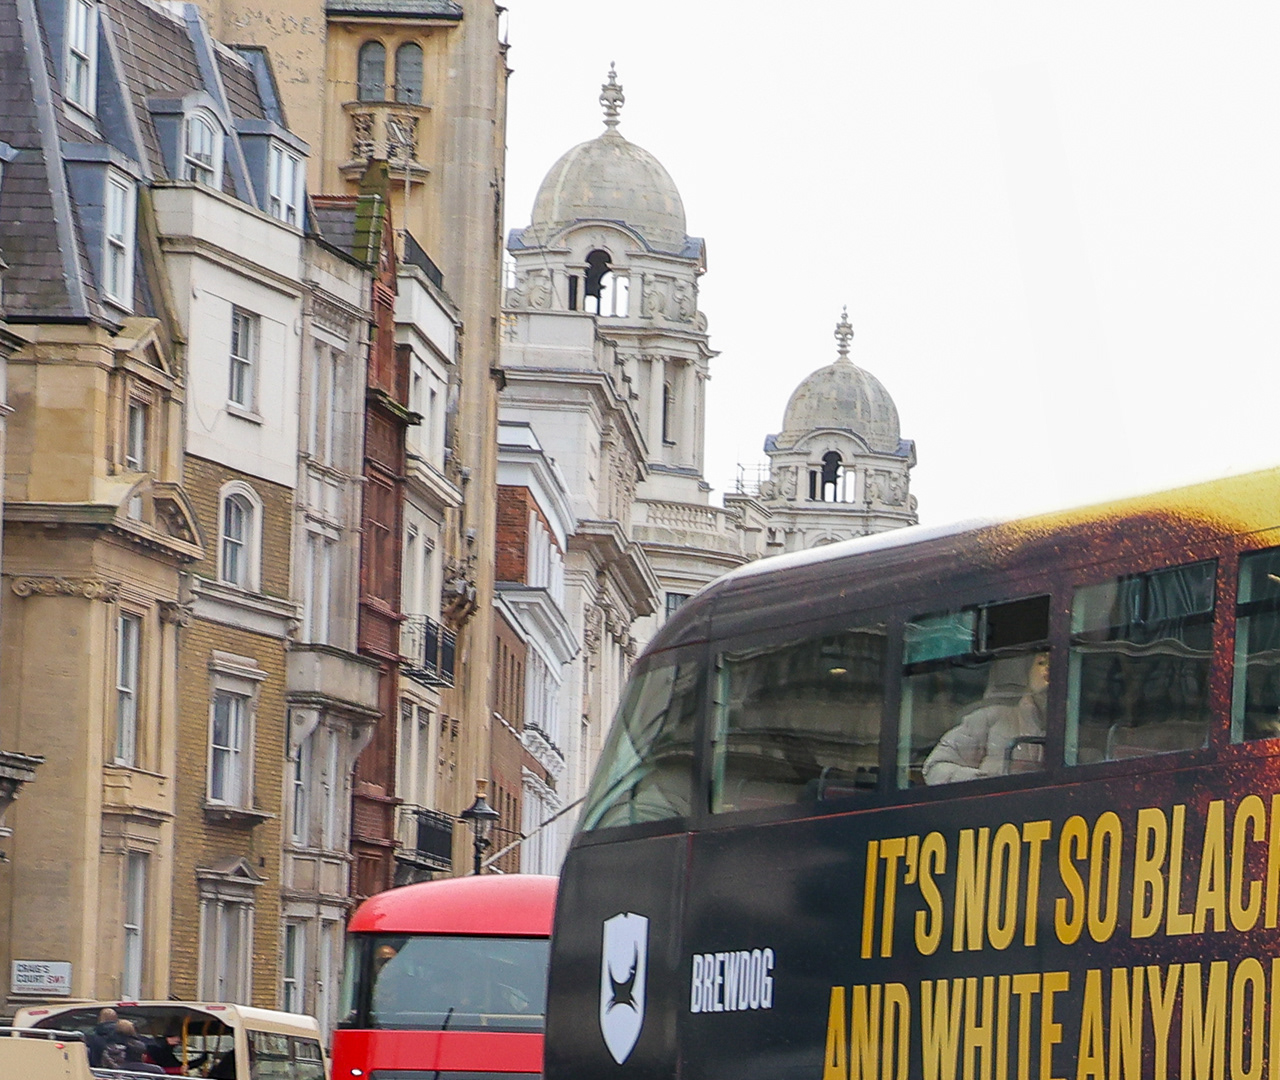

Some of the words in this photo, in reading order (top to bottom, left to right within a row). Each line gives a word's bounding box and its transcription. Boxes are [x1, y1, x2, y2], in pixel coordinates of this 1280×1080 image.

[860, 831, 948, 959] IT'S
[952, 820, 1052, 952] NOT
[1054, 811, 1123, 946] SO
[690, 947, 775, 1013] BREWDOG
